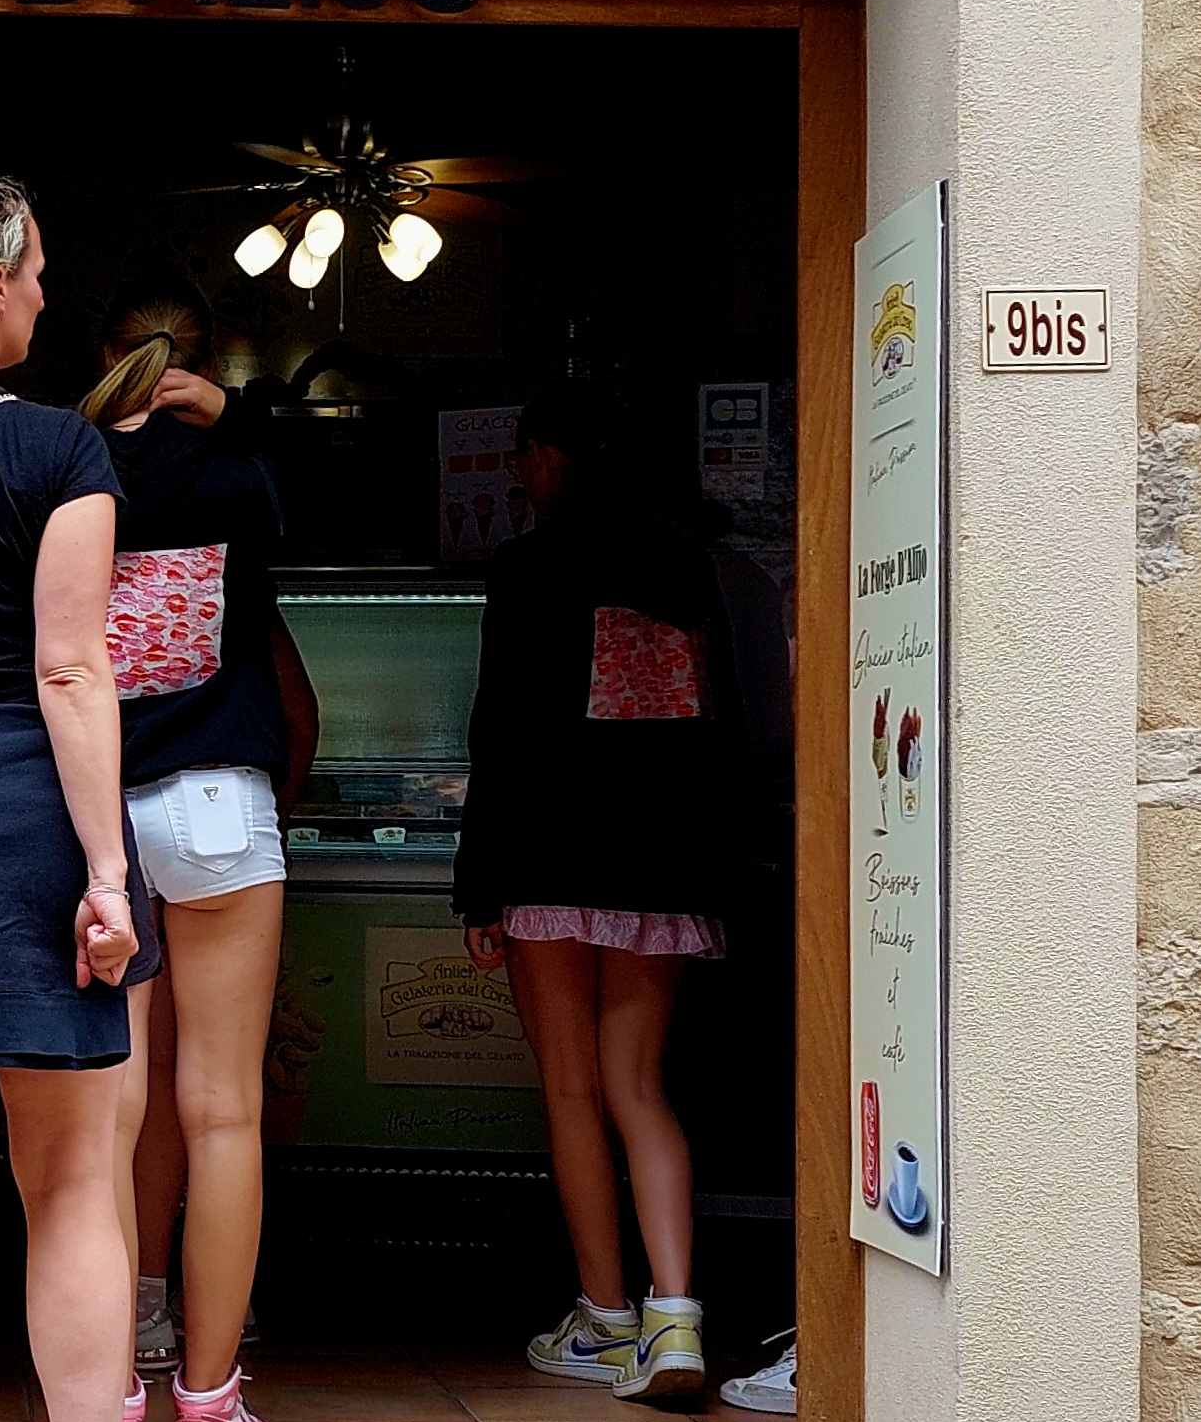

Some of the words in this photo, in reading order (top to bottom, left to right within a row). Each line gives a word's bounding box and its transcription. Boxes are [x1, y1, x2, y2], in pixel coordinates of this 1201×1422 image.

[1007, 300, 1086, 356] 9bis
[455, 414, 517, 432] GLACE
[858, 563, 869, 598] La
[870, 554, 896, 595] Forge
[390, 982, 454, 1006] Gelateria
[457, 984, 479, 997] del
[481, 984, 514, 1006] Cors
[887, 966, 900, 1009] et
[387, 1050, 400, 1058] LA
[403, 1049, 460, 1060] TRADIZIONE
[464, 1051, 483, 1060] DEL
[487, 1052, 526, 1061] GELATO
[882, 1025, 905, 1072] café
